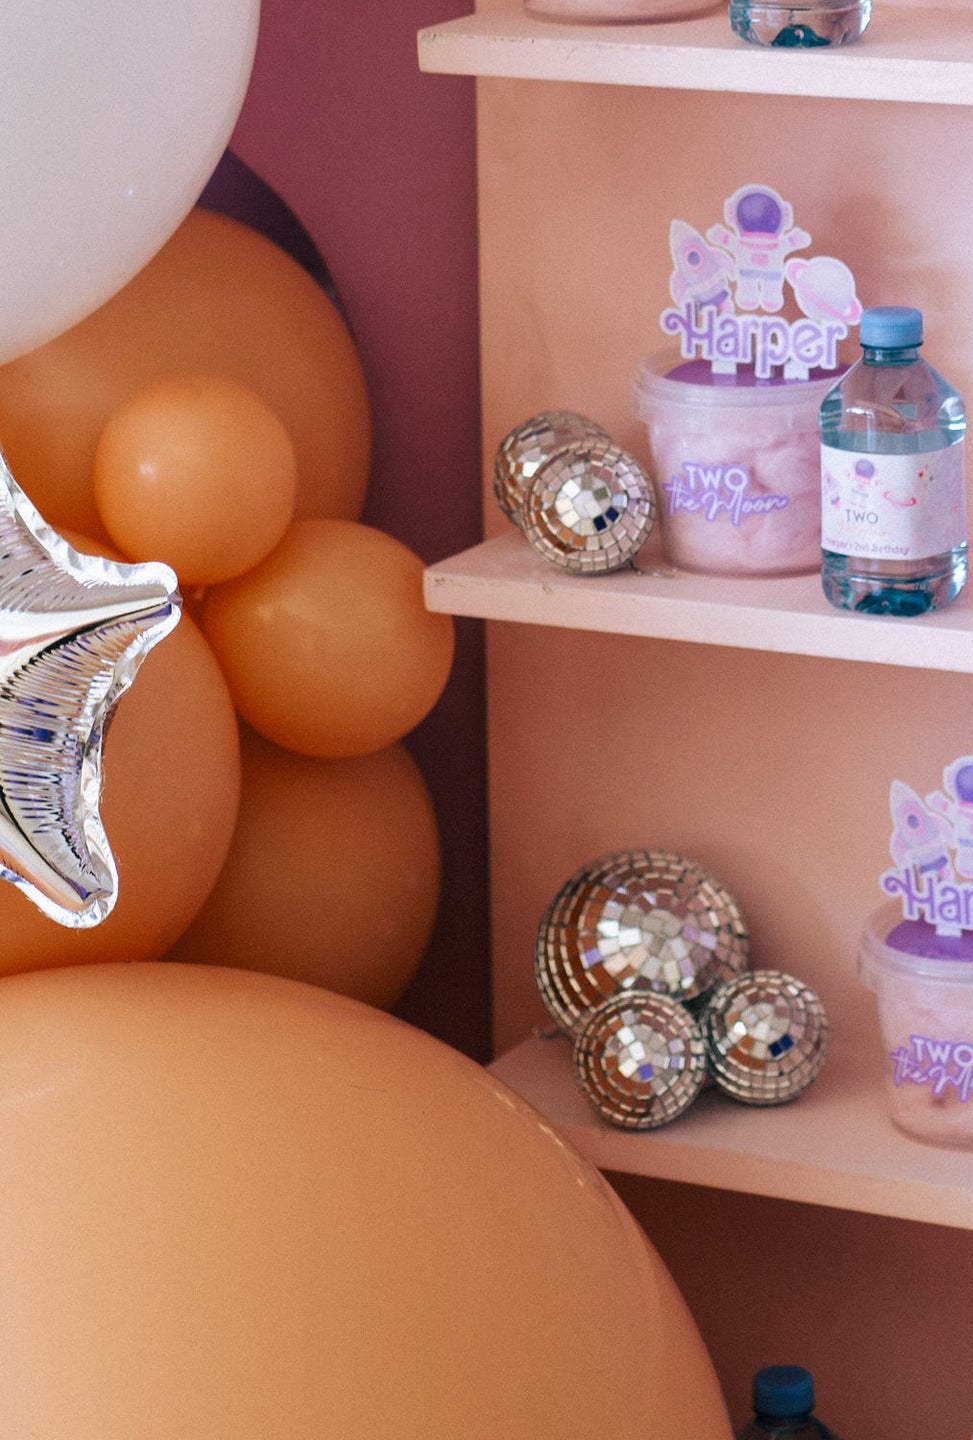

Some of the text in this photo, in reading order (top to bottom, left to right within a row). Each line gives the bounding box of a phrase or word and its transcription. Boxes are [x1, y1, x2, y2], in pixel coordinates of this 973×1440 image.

[664, 302, 845, 373] Harper
[684, 465, 748, 491] TWO
[664, 477, 788, 525] the Moon
[845, 509, 879, 525] TWO
[890, 1047, 927, 1086] the
